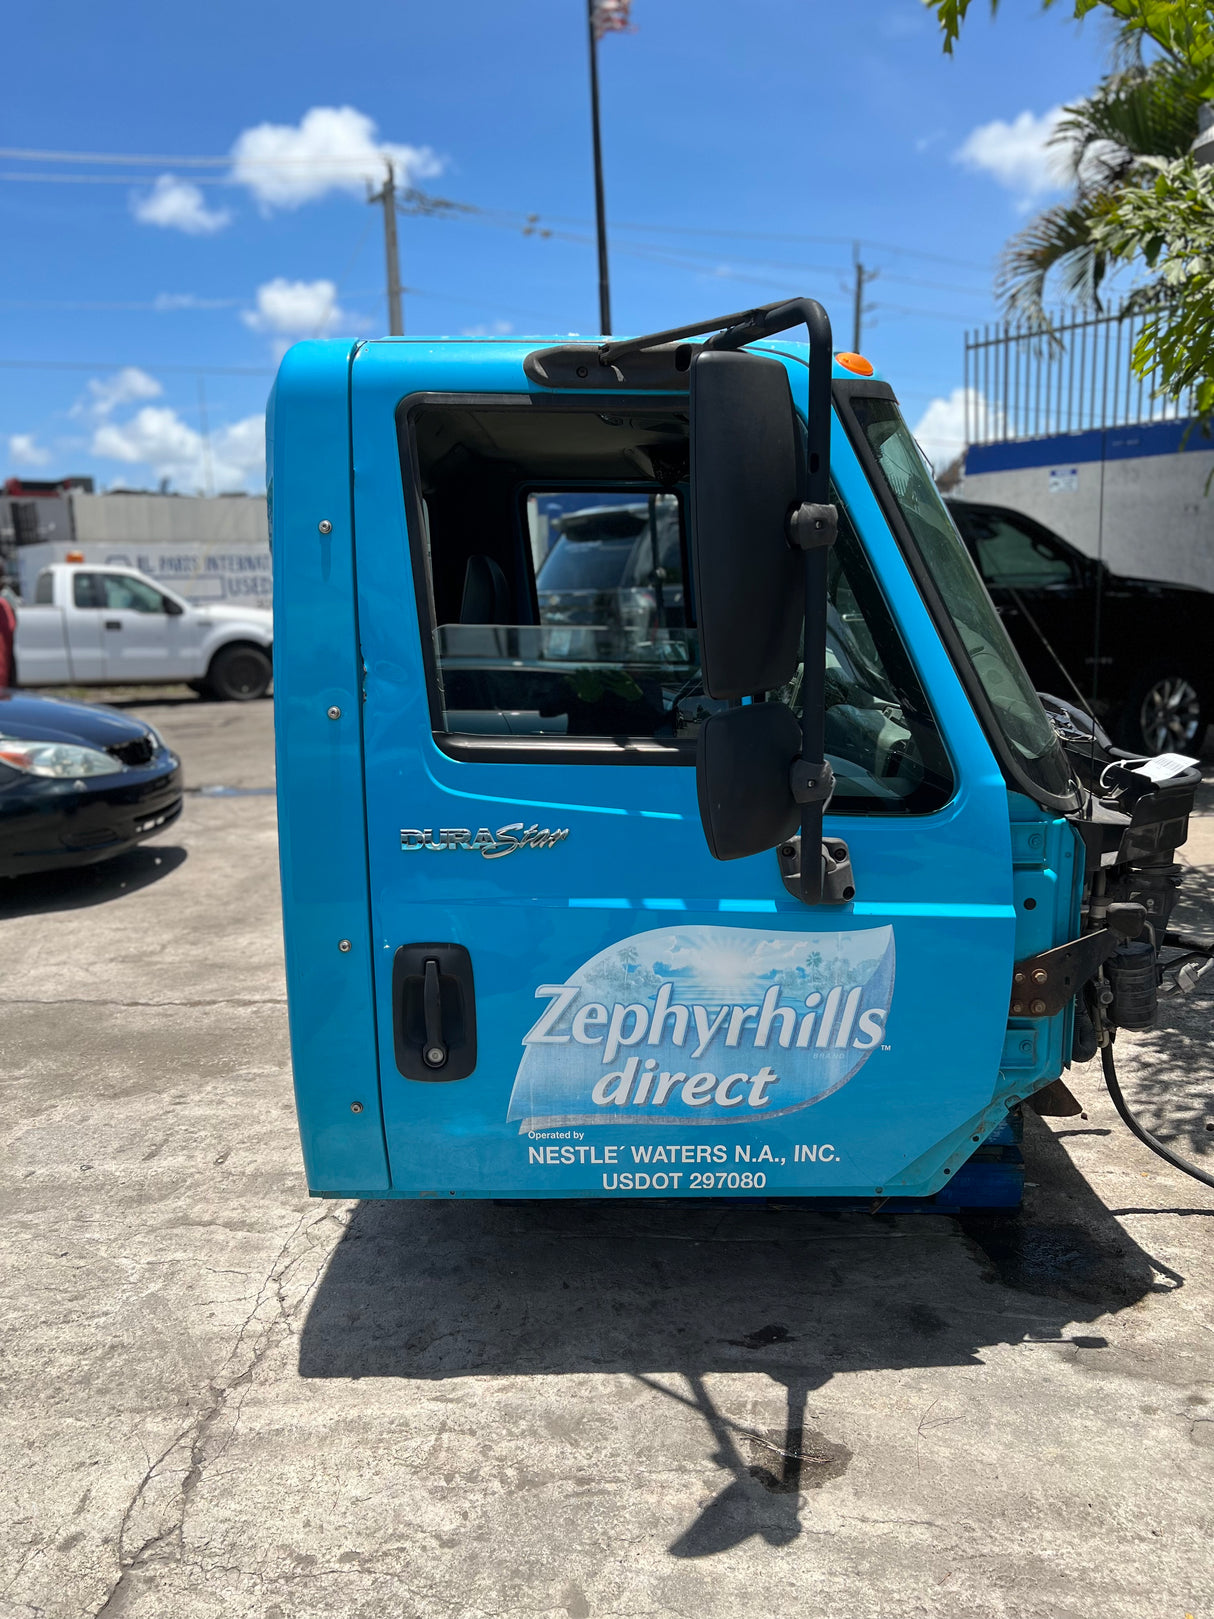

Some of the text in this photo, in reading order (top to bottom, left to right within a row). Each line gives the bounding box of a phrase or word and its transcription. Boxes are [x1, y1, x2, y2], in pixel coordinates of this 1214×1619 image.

[522, 982, 887, 1064] Zephyrhills
[591, 1056, 779, 1108] direct
[528, 1130, 585, 1141] Operated by
[631, 1145, 728, 1163] WATERS
[735, 1145, 786, 1166] N.A.,
[794, 1144, 841, 1162] INC.
[602, 1173, 767, 1190] USDOT 297080
